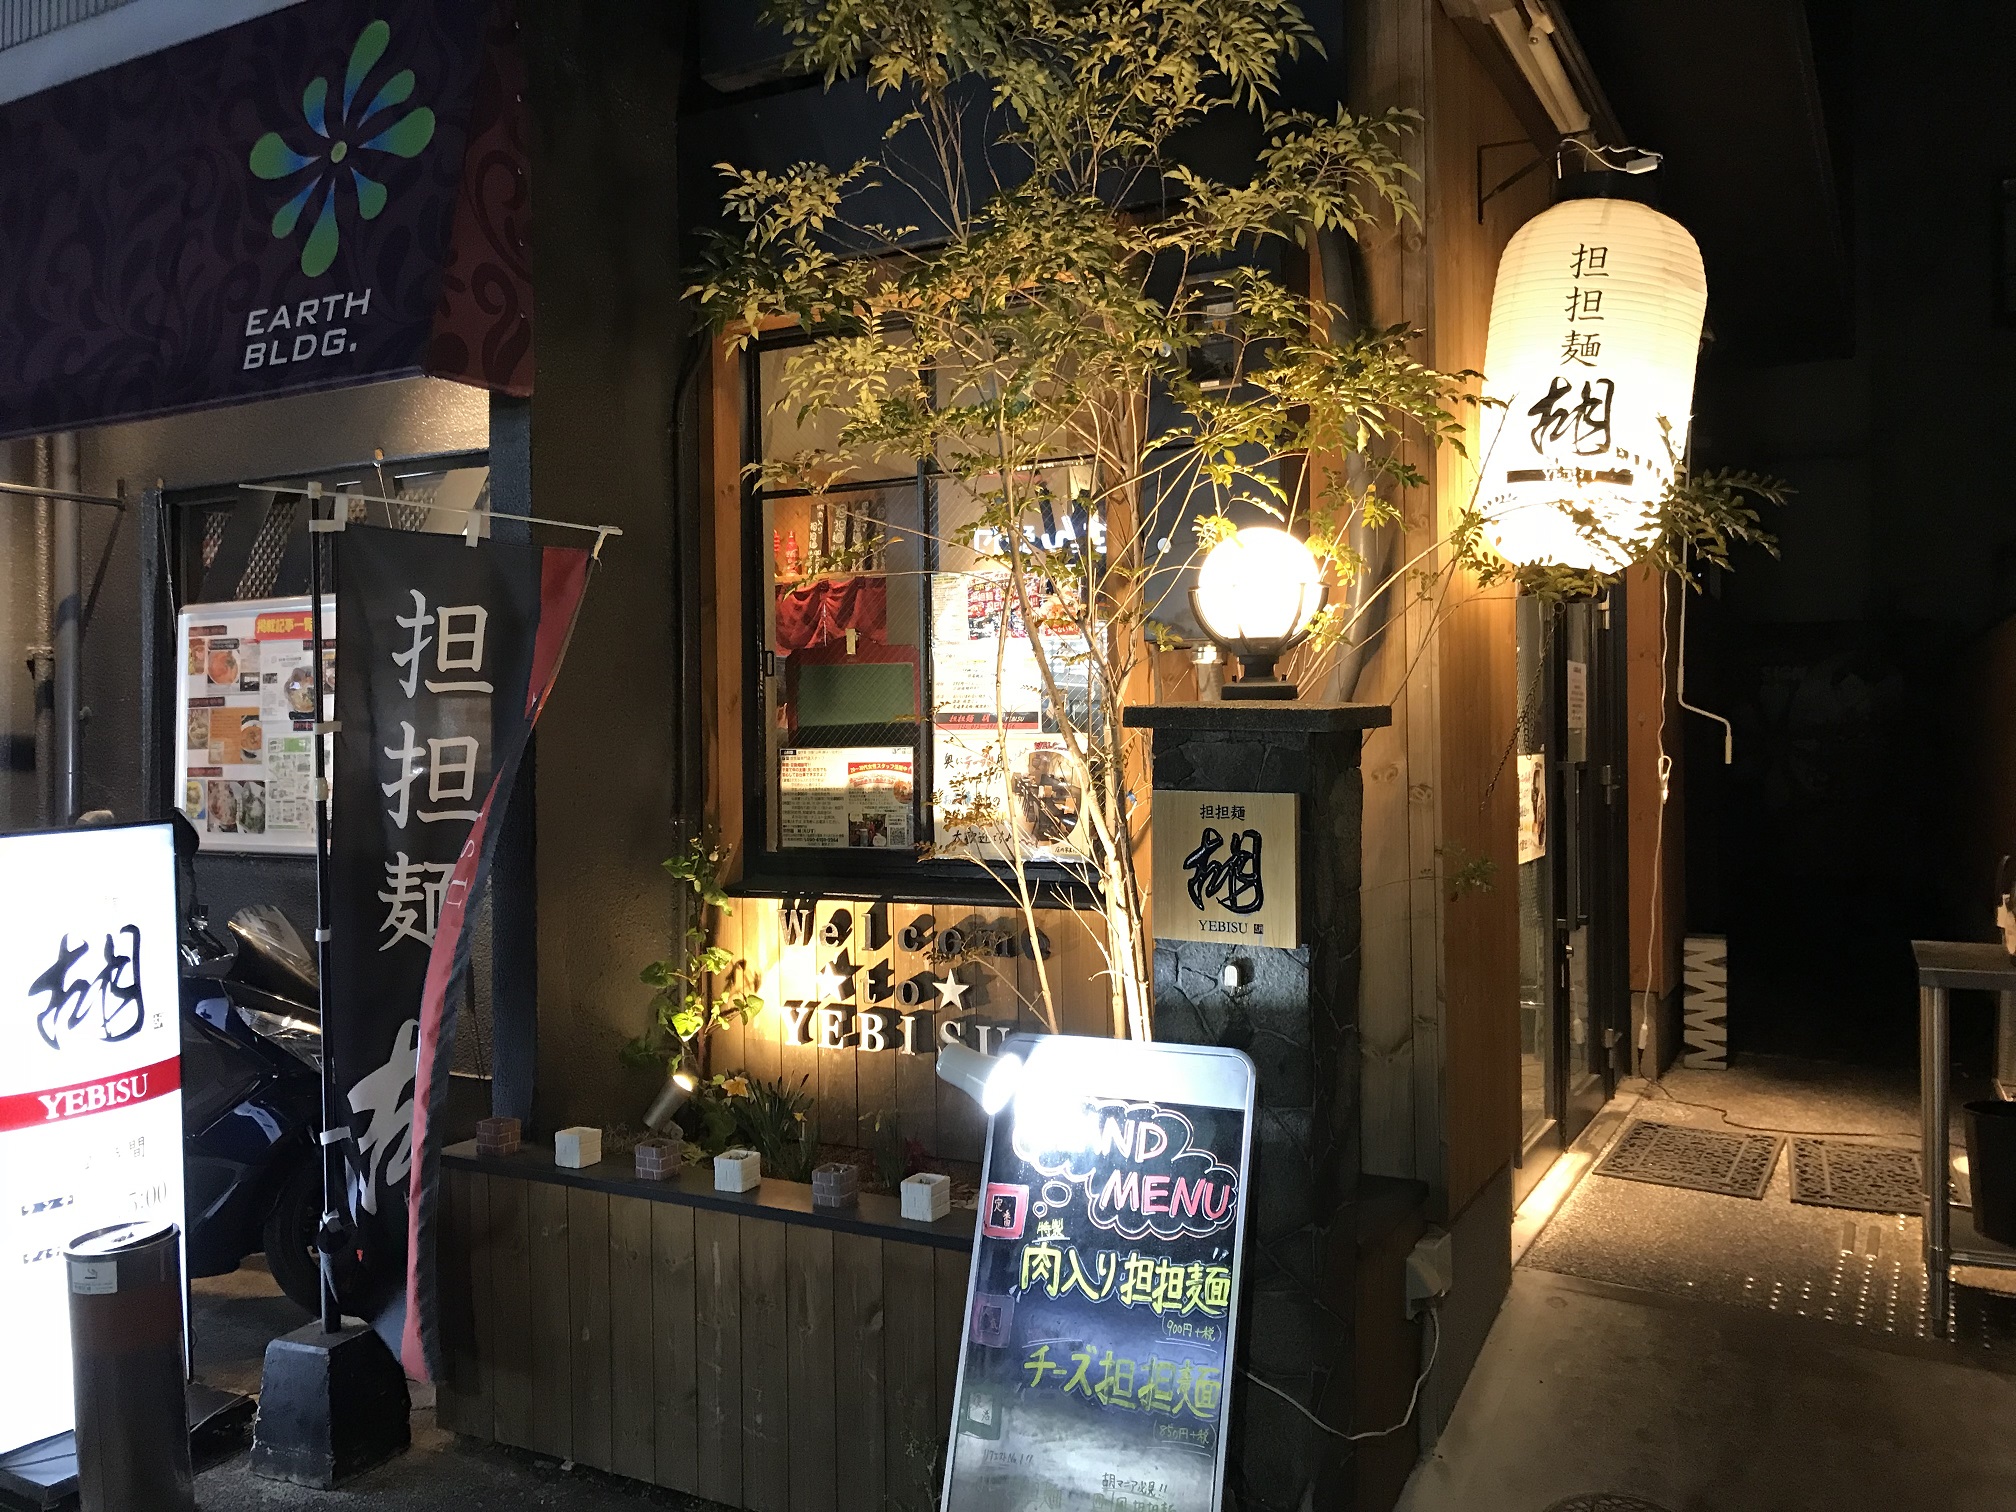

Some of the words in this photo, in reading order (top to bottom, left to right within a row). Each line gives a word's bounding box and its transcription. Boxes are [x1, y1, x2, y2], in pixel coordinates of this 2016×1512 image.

[245, 288, 372, 337] EARTH
[1560, 243, 1610, 367] 担担麺
[243, 328, 357, 370] BLDG.
[378, 588, 495, 952] 担担麺
[1200, 804, 1246, 821] 担担麺
[778, 909, 1051, 961] Welcome
[1198, 919, 1249, 934] YEBISU
[860, 970, 919, 1006] to
[779, 1006, 1010, 1057] YEBISU
[39, 1073, 149, 1120] YEBISU
[1099, 1168, 1231, 1221] MENU
[1020, 1242, 1232, 1316] 肉入り担担麺
[1023, 1344, 1223, 1418] チーズ担担麺
